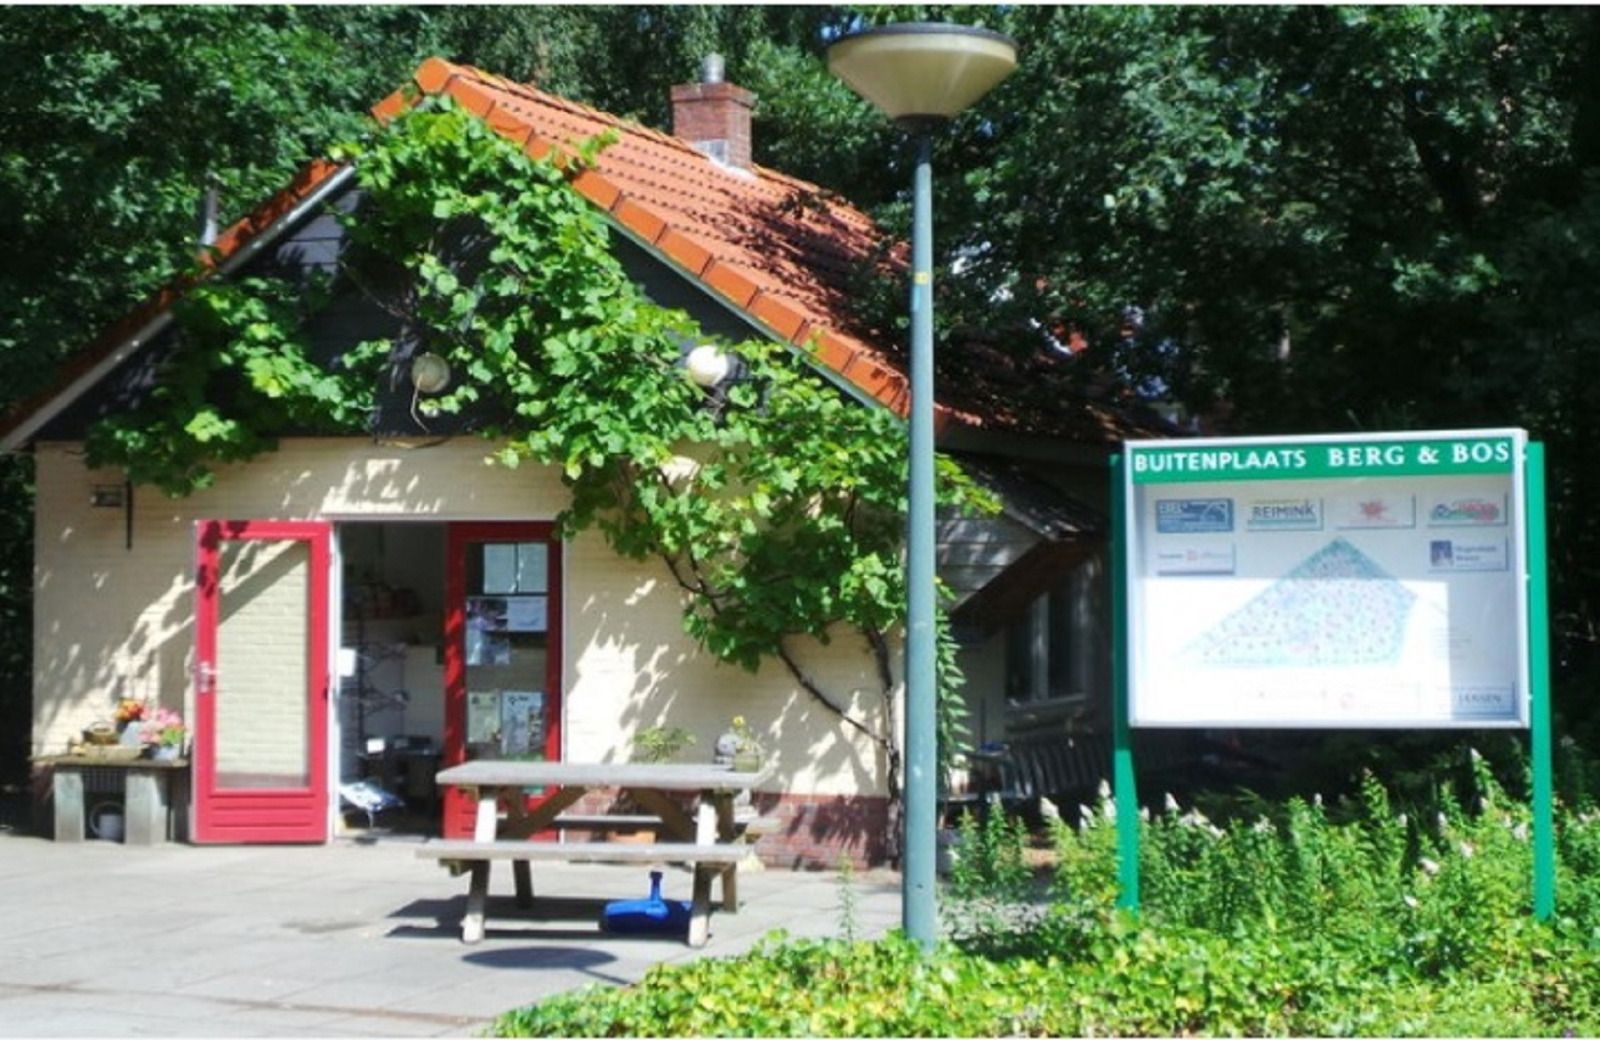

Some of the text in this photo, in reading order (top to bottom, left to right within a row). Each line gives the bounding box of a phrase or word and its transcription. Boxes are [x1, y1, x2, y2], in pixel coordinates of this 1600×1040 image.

[1134, 442, 1510, 472] BUITENPLAATS BERG & BOS
[1252, 502, 1316, 519] REIMINK
